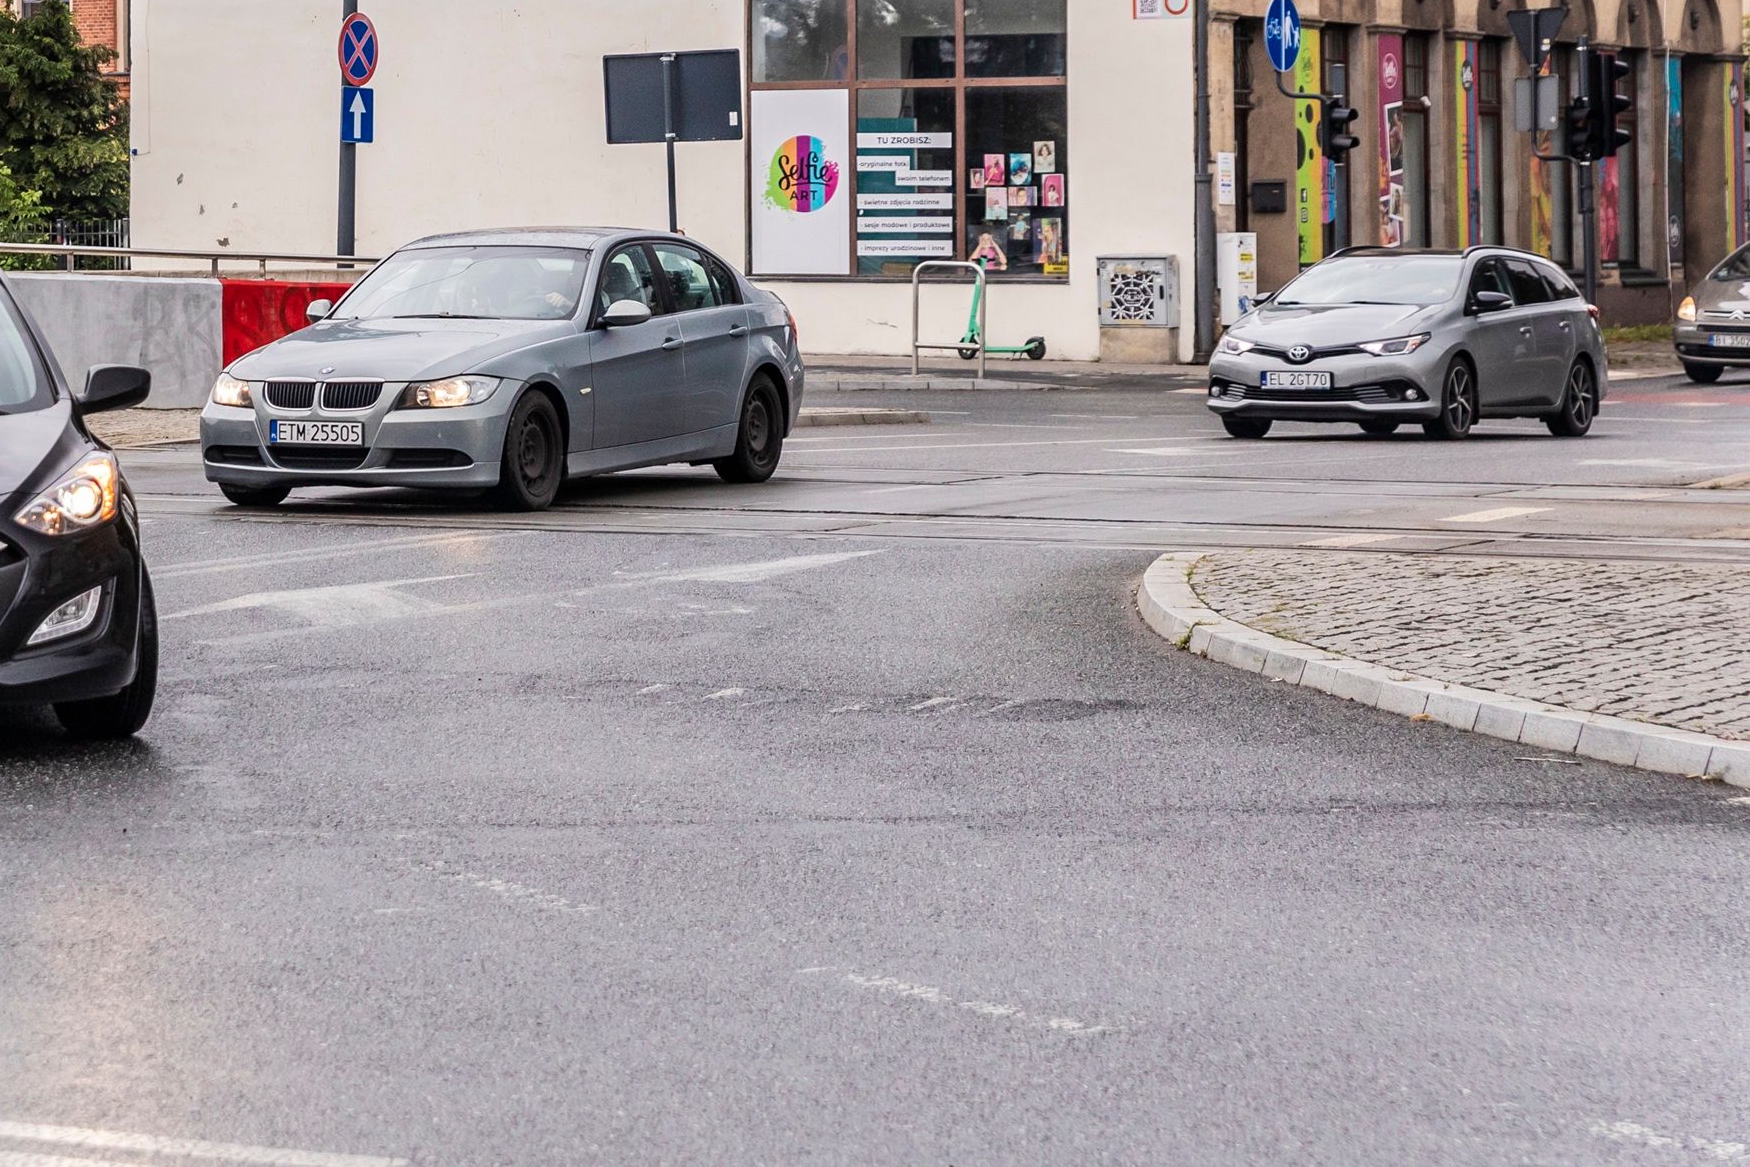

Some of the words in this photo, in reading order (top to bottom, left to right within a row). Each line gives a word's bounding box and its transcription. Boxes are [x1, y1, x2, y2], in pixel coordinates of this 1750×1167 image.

[778, 151, 832, 190] Selfie
[790, 190, 818, 201] ART
[1269, 373, 1285, 386] EL
[1289, 373, 1328, 386] 2GT70
[278, 423, 307, 441] ETM
[310, 424, 360, 443] 25505
